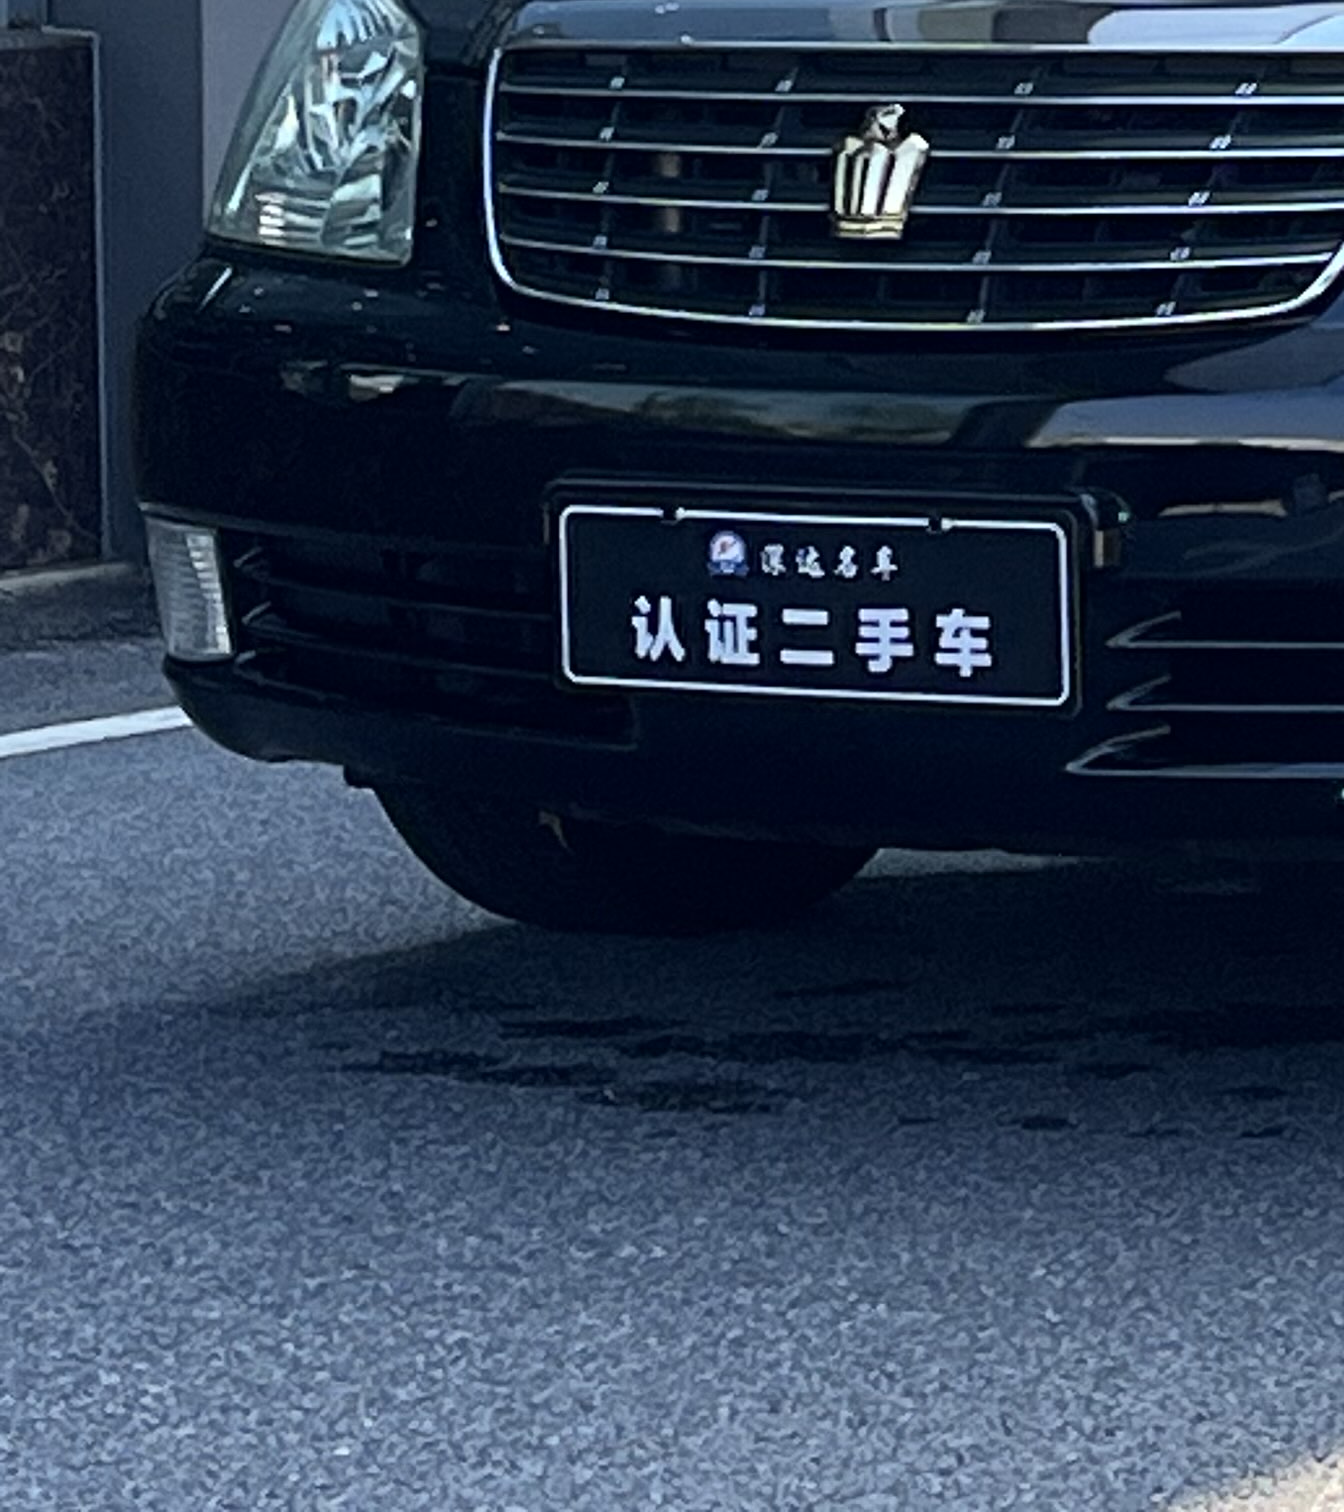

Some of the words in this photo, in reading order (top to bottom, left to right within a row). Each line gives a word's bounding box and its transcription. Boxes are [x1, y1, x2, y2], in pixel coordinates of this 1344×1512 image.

[630, 595, 993, 678] 认证二手车
